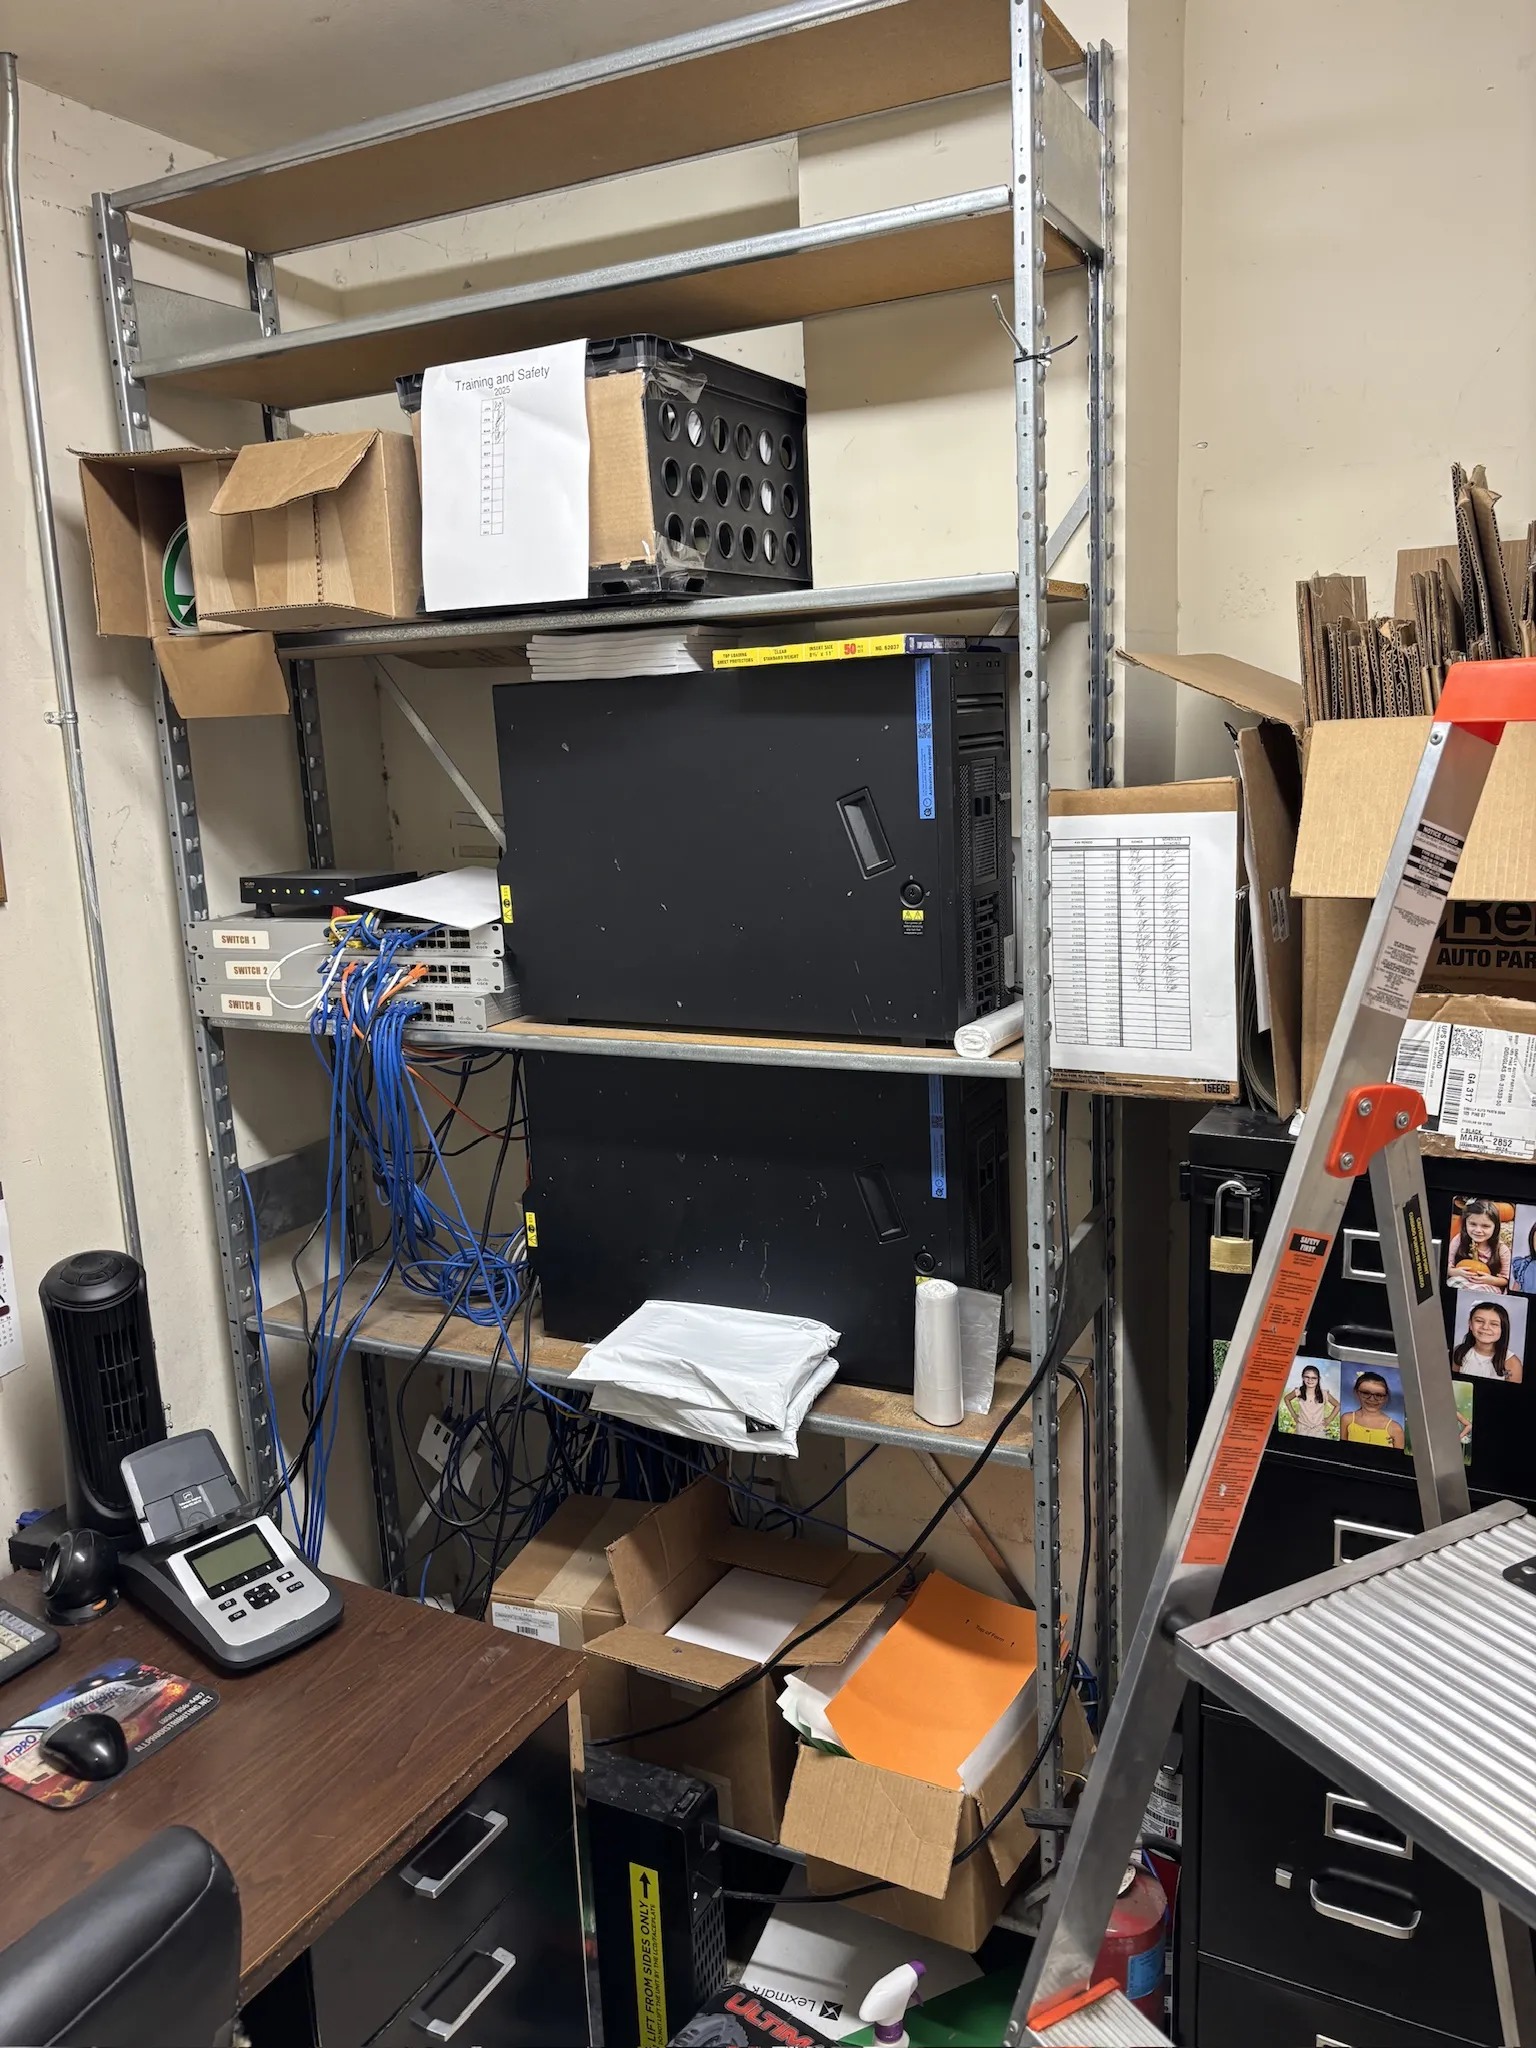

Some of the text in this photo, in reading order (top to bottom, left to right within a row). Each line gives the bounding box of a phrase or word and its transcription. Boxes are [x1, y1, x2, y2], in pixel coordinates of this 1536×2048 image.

[455, 366, 550, 391] Training and Safety
[494, 386, 510, 396] 2025
[844, 643, 856, 655] 50
[222, 935, 250, 944] SWITCH
[1436, 948, 1491, 968] AUTO
[234, 966, 261, 974] SWITCH
[228, 1000, 261, 1010] SWITCH 6
[1436, 1040, 1446, 1069] GROUND
[1465, 1073, 1476, 1103] GA 317
[1460, 1134, 1484, 1143] MARK
[1493, 1138, 1512, 1148] 2852
[1300, 1236, 1320, 1246] SAFETY
[1300, 1244, 1316, 1253] FIRST
[976, 1624, 984, 1632] Top
[991, 1633, 1004, 1642] Form
[134, 1695, 214, 1752] ALLPRODISTRIBUTING.NET
[4, 1735, 36, 1766] ALLPRO
[639, 1900, 656, 2042] LIFT FROM SIDES ONLY
[654, 1970, 660, 1979] BY
[752, 1985, 816, 2012] Lexmark
